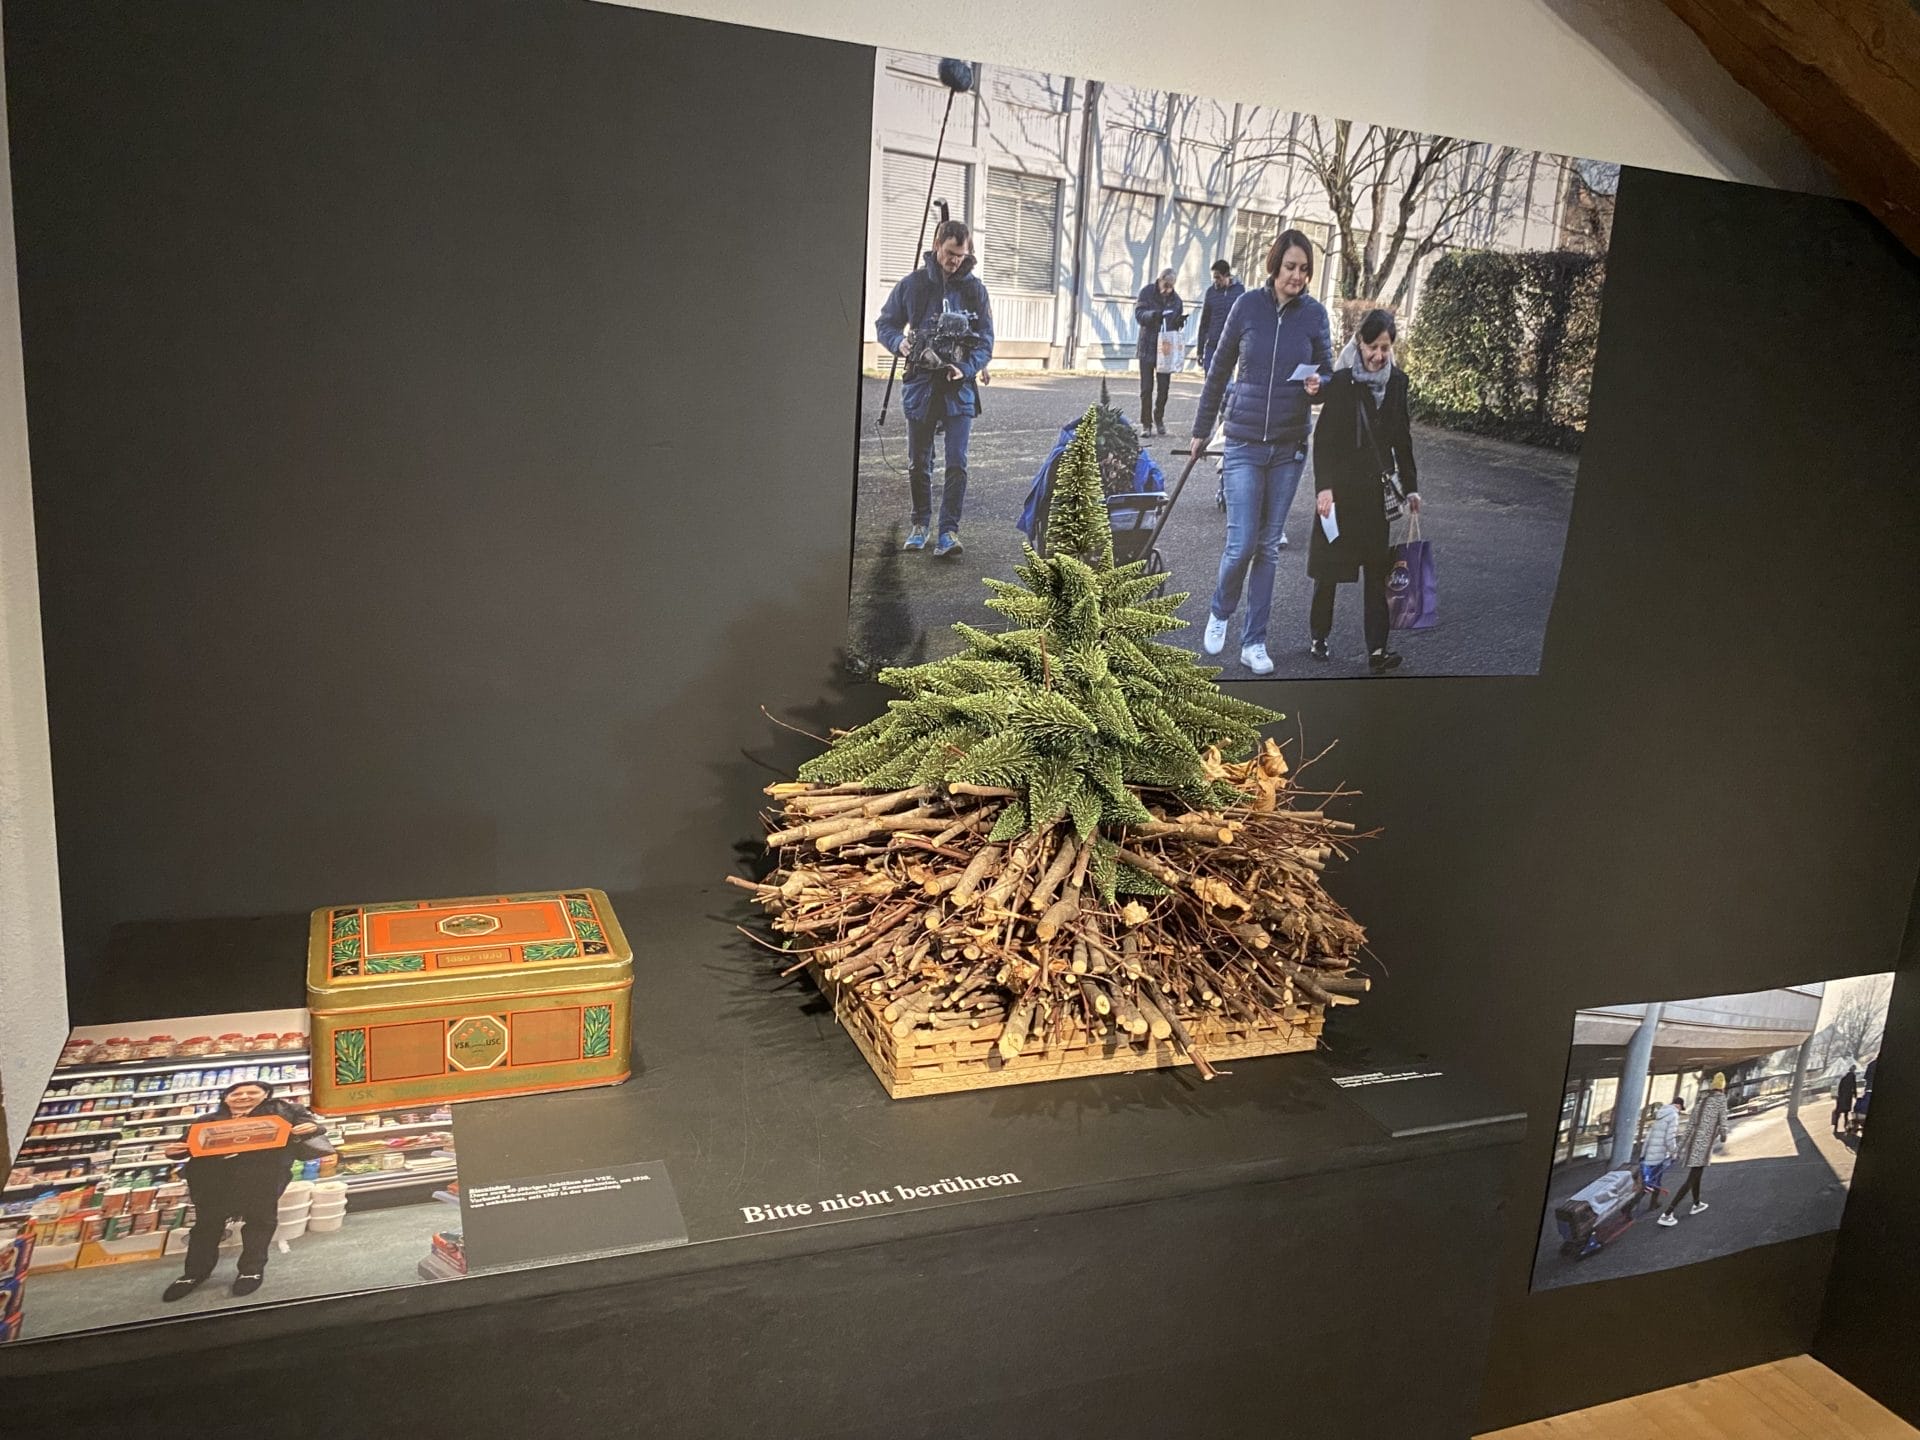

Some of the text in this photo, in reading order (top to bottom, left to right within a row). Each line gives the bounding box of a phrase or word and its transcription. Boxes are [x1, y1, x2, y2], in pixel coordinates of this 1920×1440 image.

[454, 1038, 501, 1049] VSK USC
[348, 1088, 375, 1100] VSK
[739, 1171, 1022, 1224] Bitte nicht berühren
